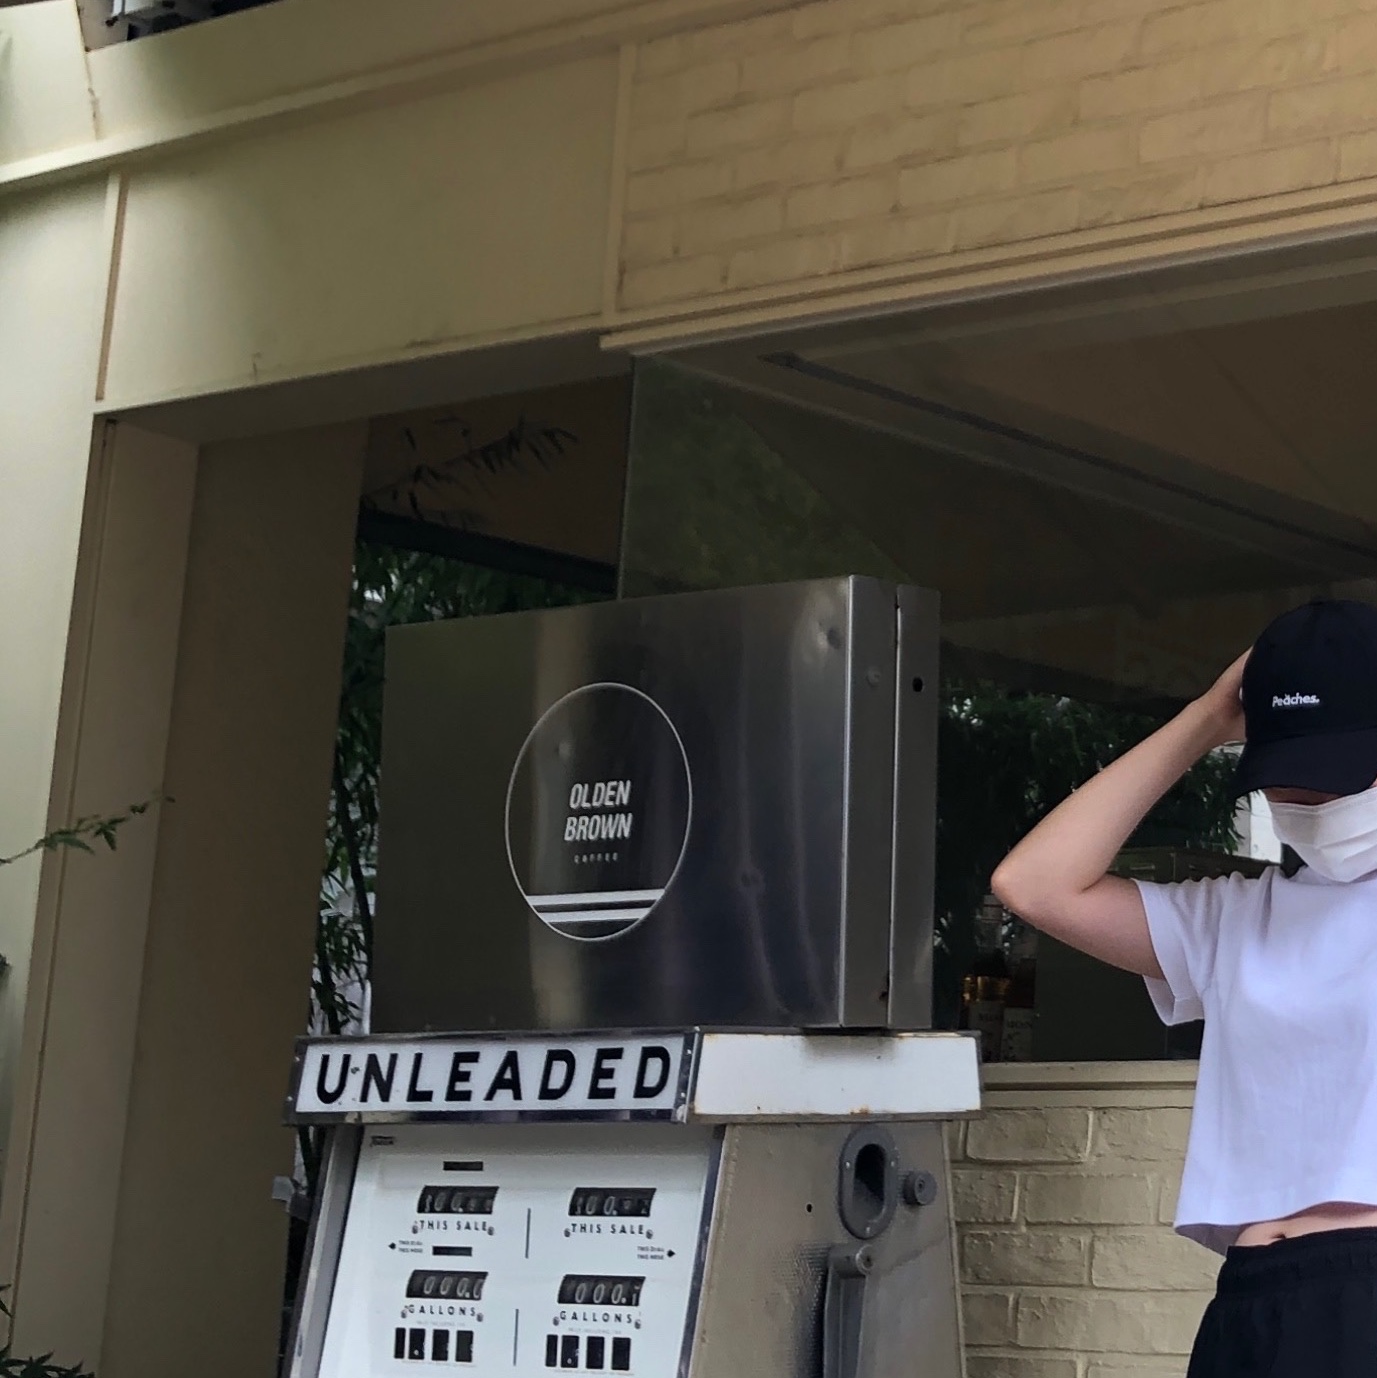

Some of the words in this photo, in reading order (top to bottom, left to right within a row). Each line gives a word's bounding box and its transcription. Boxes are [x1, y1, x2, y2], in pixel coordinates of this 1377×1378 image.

[569, 779, 632, 809] OLDEN
[563, 812, 633, 842] BROWN
[316, 1046, 671, 1104] UNLEADED
[420, 1219, 448, 1231] THIS
[456, 1220, 488, 1232] SALE
[571, 1222, 602, 1234] THIS
[610, 1224, 645, 1236] SALE
[406, 1304, 476, 1317] GALLONS
[560, 1310, 633, 1324] GALLONS
